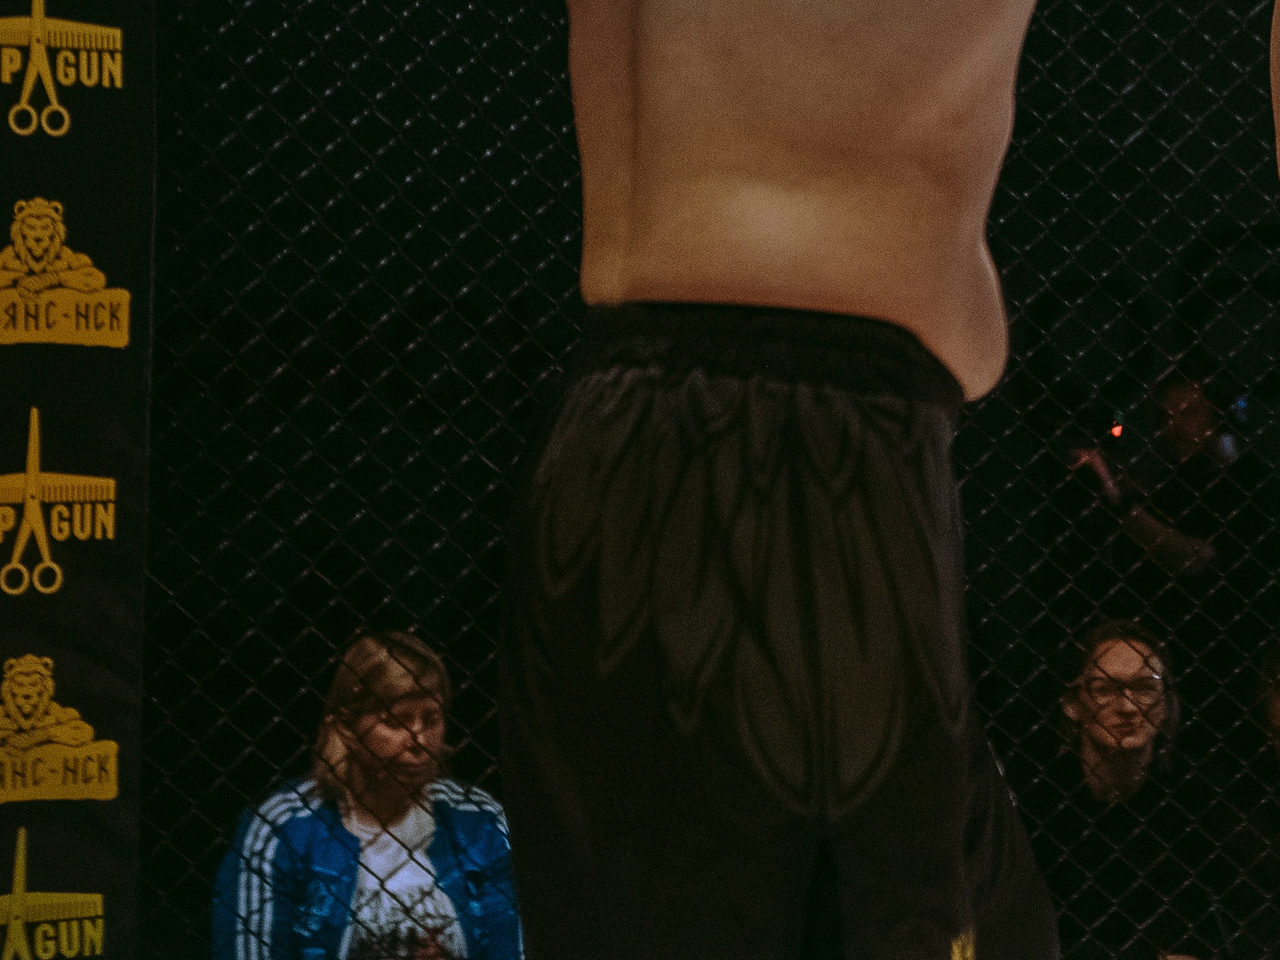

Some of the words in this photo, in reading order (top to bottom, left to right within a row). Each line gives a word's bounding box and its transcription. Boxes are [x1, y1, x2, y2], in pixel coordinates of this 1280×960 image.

[55, 48, 123, 90] GUN
[50, 502, 116, 542] GUN
[34, 917, 104, 960] GUN
